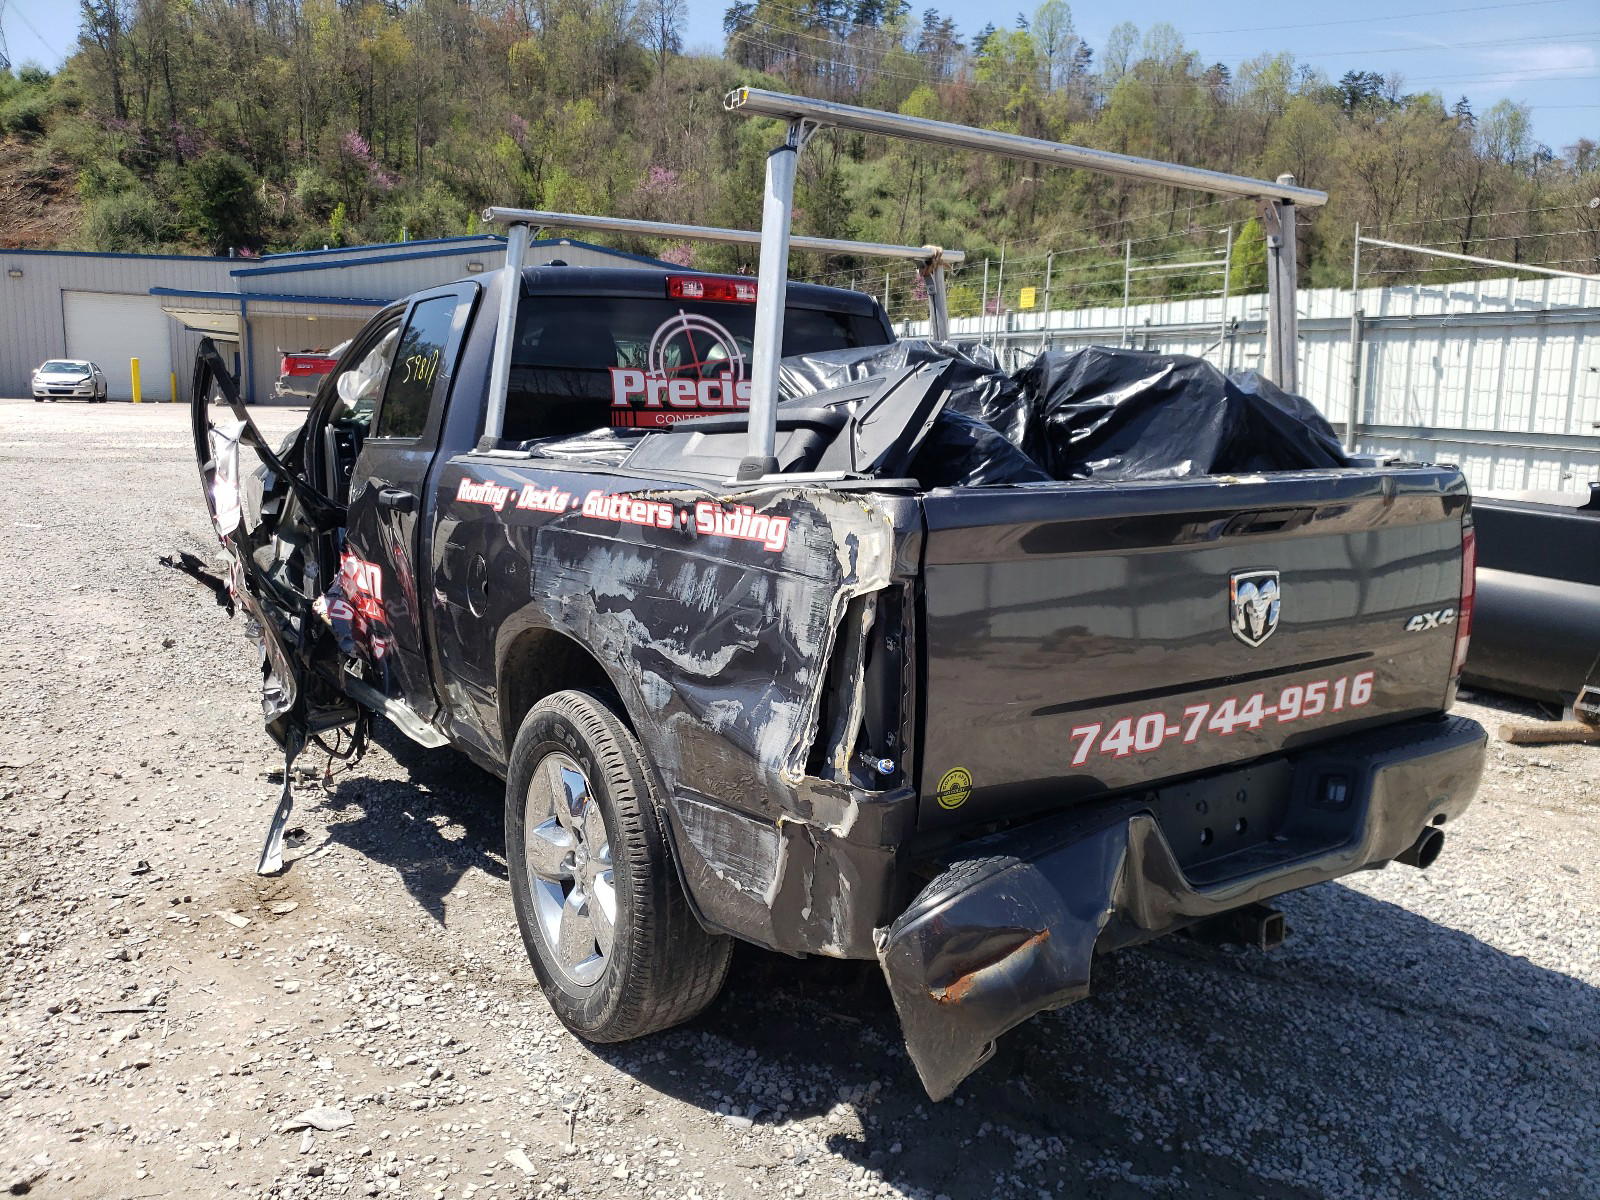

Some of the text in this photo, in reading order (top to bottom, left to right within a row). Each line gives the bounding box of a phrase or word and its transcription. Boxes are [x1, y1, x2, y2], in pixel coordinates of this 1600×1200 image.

[456, 477, 791, 554] Roofing Decks Gutters Siding
[1068, 670, 1376, 768] 740-744-9516
